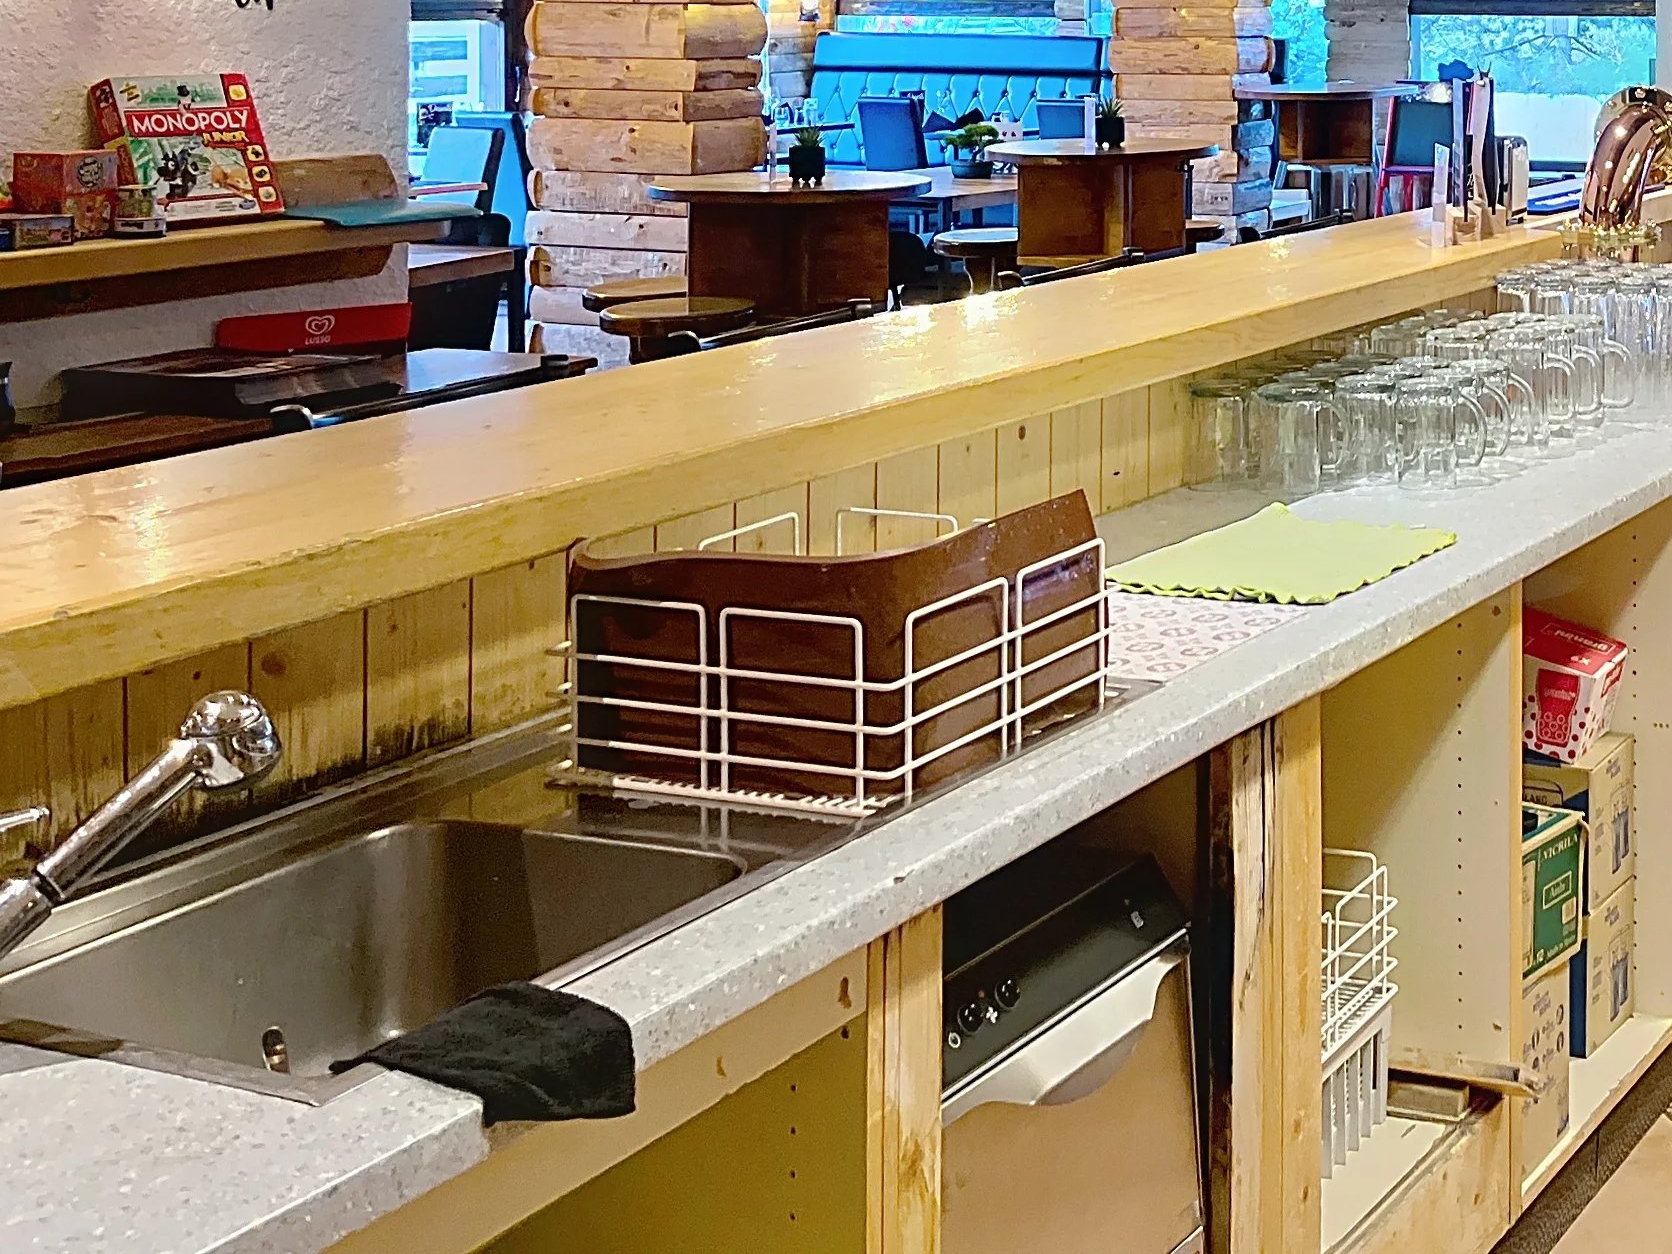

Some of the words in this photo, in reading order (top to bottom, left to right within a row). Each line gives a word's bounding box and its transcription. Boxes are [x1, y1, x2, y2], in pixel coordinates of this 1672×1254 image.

[131, 109, 249, 134] MONOPOLY
[202, 130, 250, 144] JUNIOR
[304, 335, 332, 345] LUSSO
